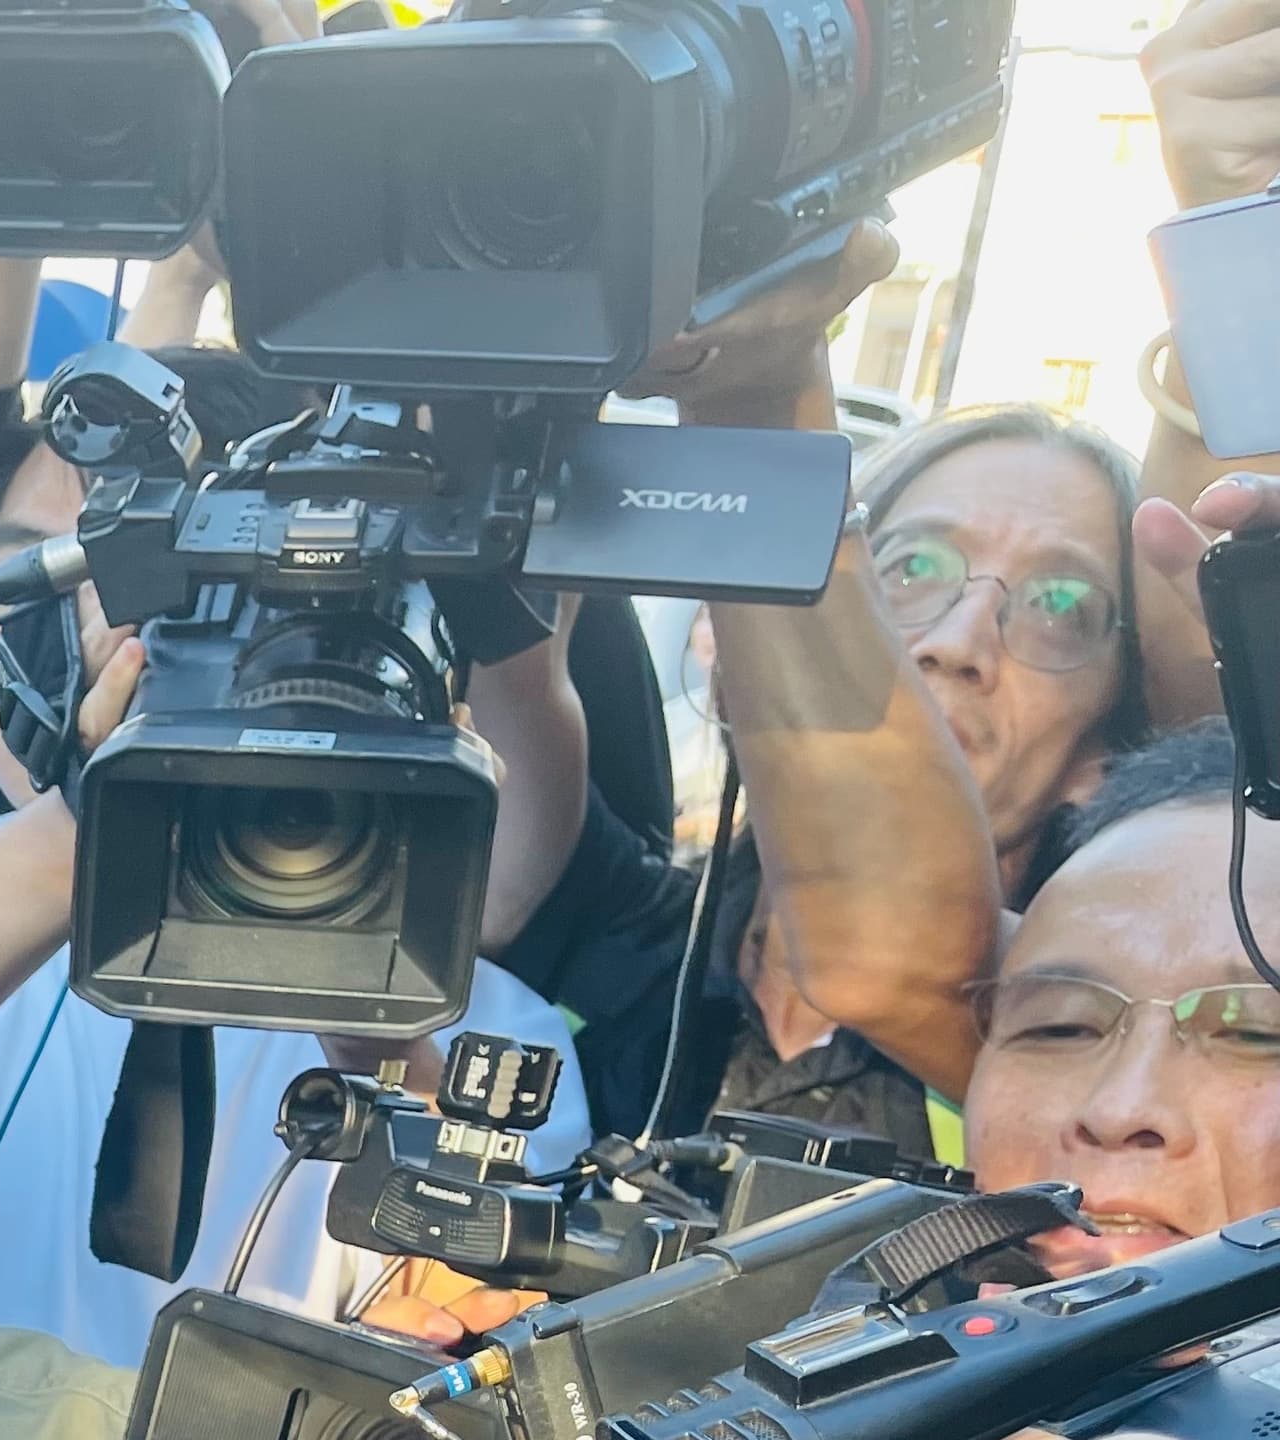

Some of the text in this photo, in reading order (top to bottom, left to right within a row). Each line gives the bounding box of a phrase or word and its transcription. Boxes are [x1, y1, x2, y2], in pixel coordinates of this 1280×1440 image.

[619, 488, 748, 513] XDCAM
[293, 551, 345, 565] SONY
[416, 1180, 472, 1206] Panasonic
[564, 1382, 589, 1431] WR-30
